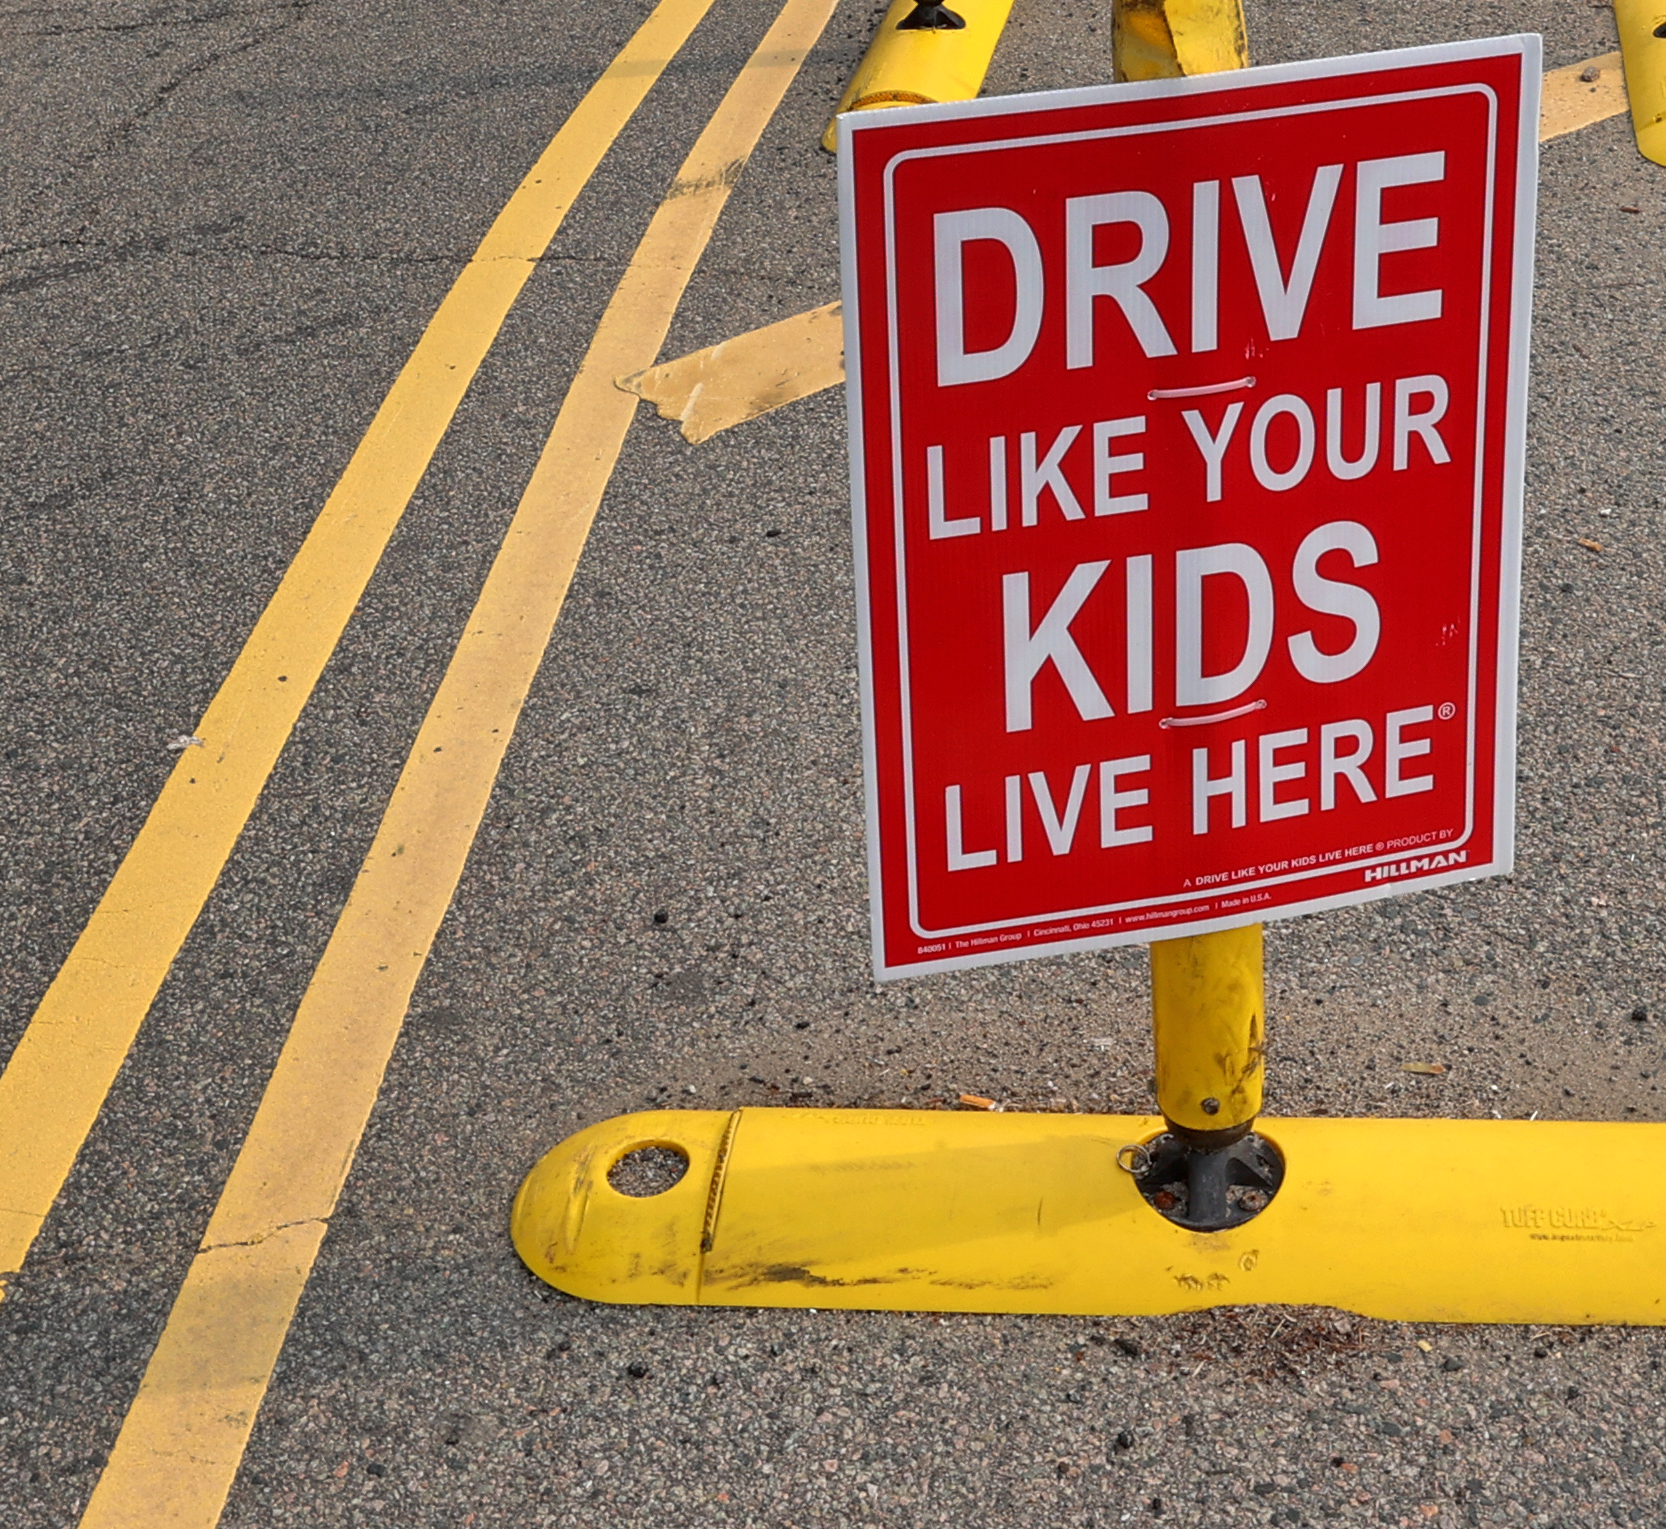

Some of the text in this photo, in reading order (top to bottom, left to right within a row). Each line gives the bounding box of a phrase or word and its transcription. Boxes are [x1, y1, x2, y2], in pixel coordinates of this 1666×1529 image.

[933, 150, 1446, 388] DRIVE
[926, 374, 1452, 540] LIKE YOUR
[1002, 520, 1381, 733] KIDS
[945, 754, 1153, 872] LIVE
[1183, 878, 1192, 888] A
[1195, 872, 1228, 886] DRIVE
[1231, 867, 1256, 880] LIKE
[1257, 860, 1289, 874] YOUR
[1291, 854, 1317, 868] KIDS
[1319, 849, 1343, 863] LIVE
[1344, 844, 1374, 858] HERE
[1386, 831, 1438, 850] PRODUCT
[1439, 828, 1454, 840] BY
[1364, 850, 1468, 882] HILLMAN
[917, 942, 947, 954] 840051
[955, 939, 970, 949] The
[970, 935, 999, 947] Hillman
[999, 932, 1023, 944] Group
[1072, 922, 1090, 932] Ohio
[1091, 918, 1115, 929] 45231
[1125, 904, 1210, 924] www.hillmangroup.com
[1221, 899, 1241, 910] Made
[1242, 898, 1250, 906] in
[1250, 892, 1273, 904] U.S.A.
